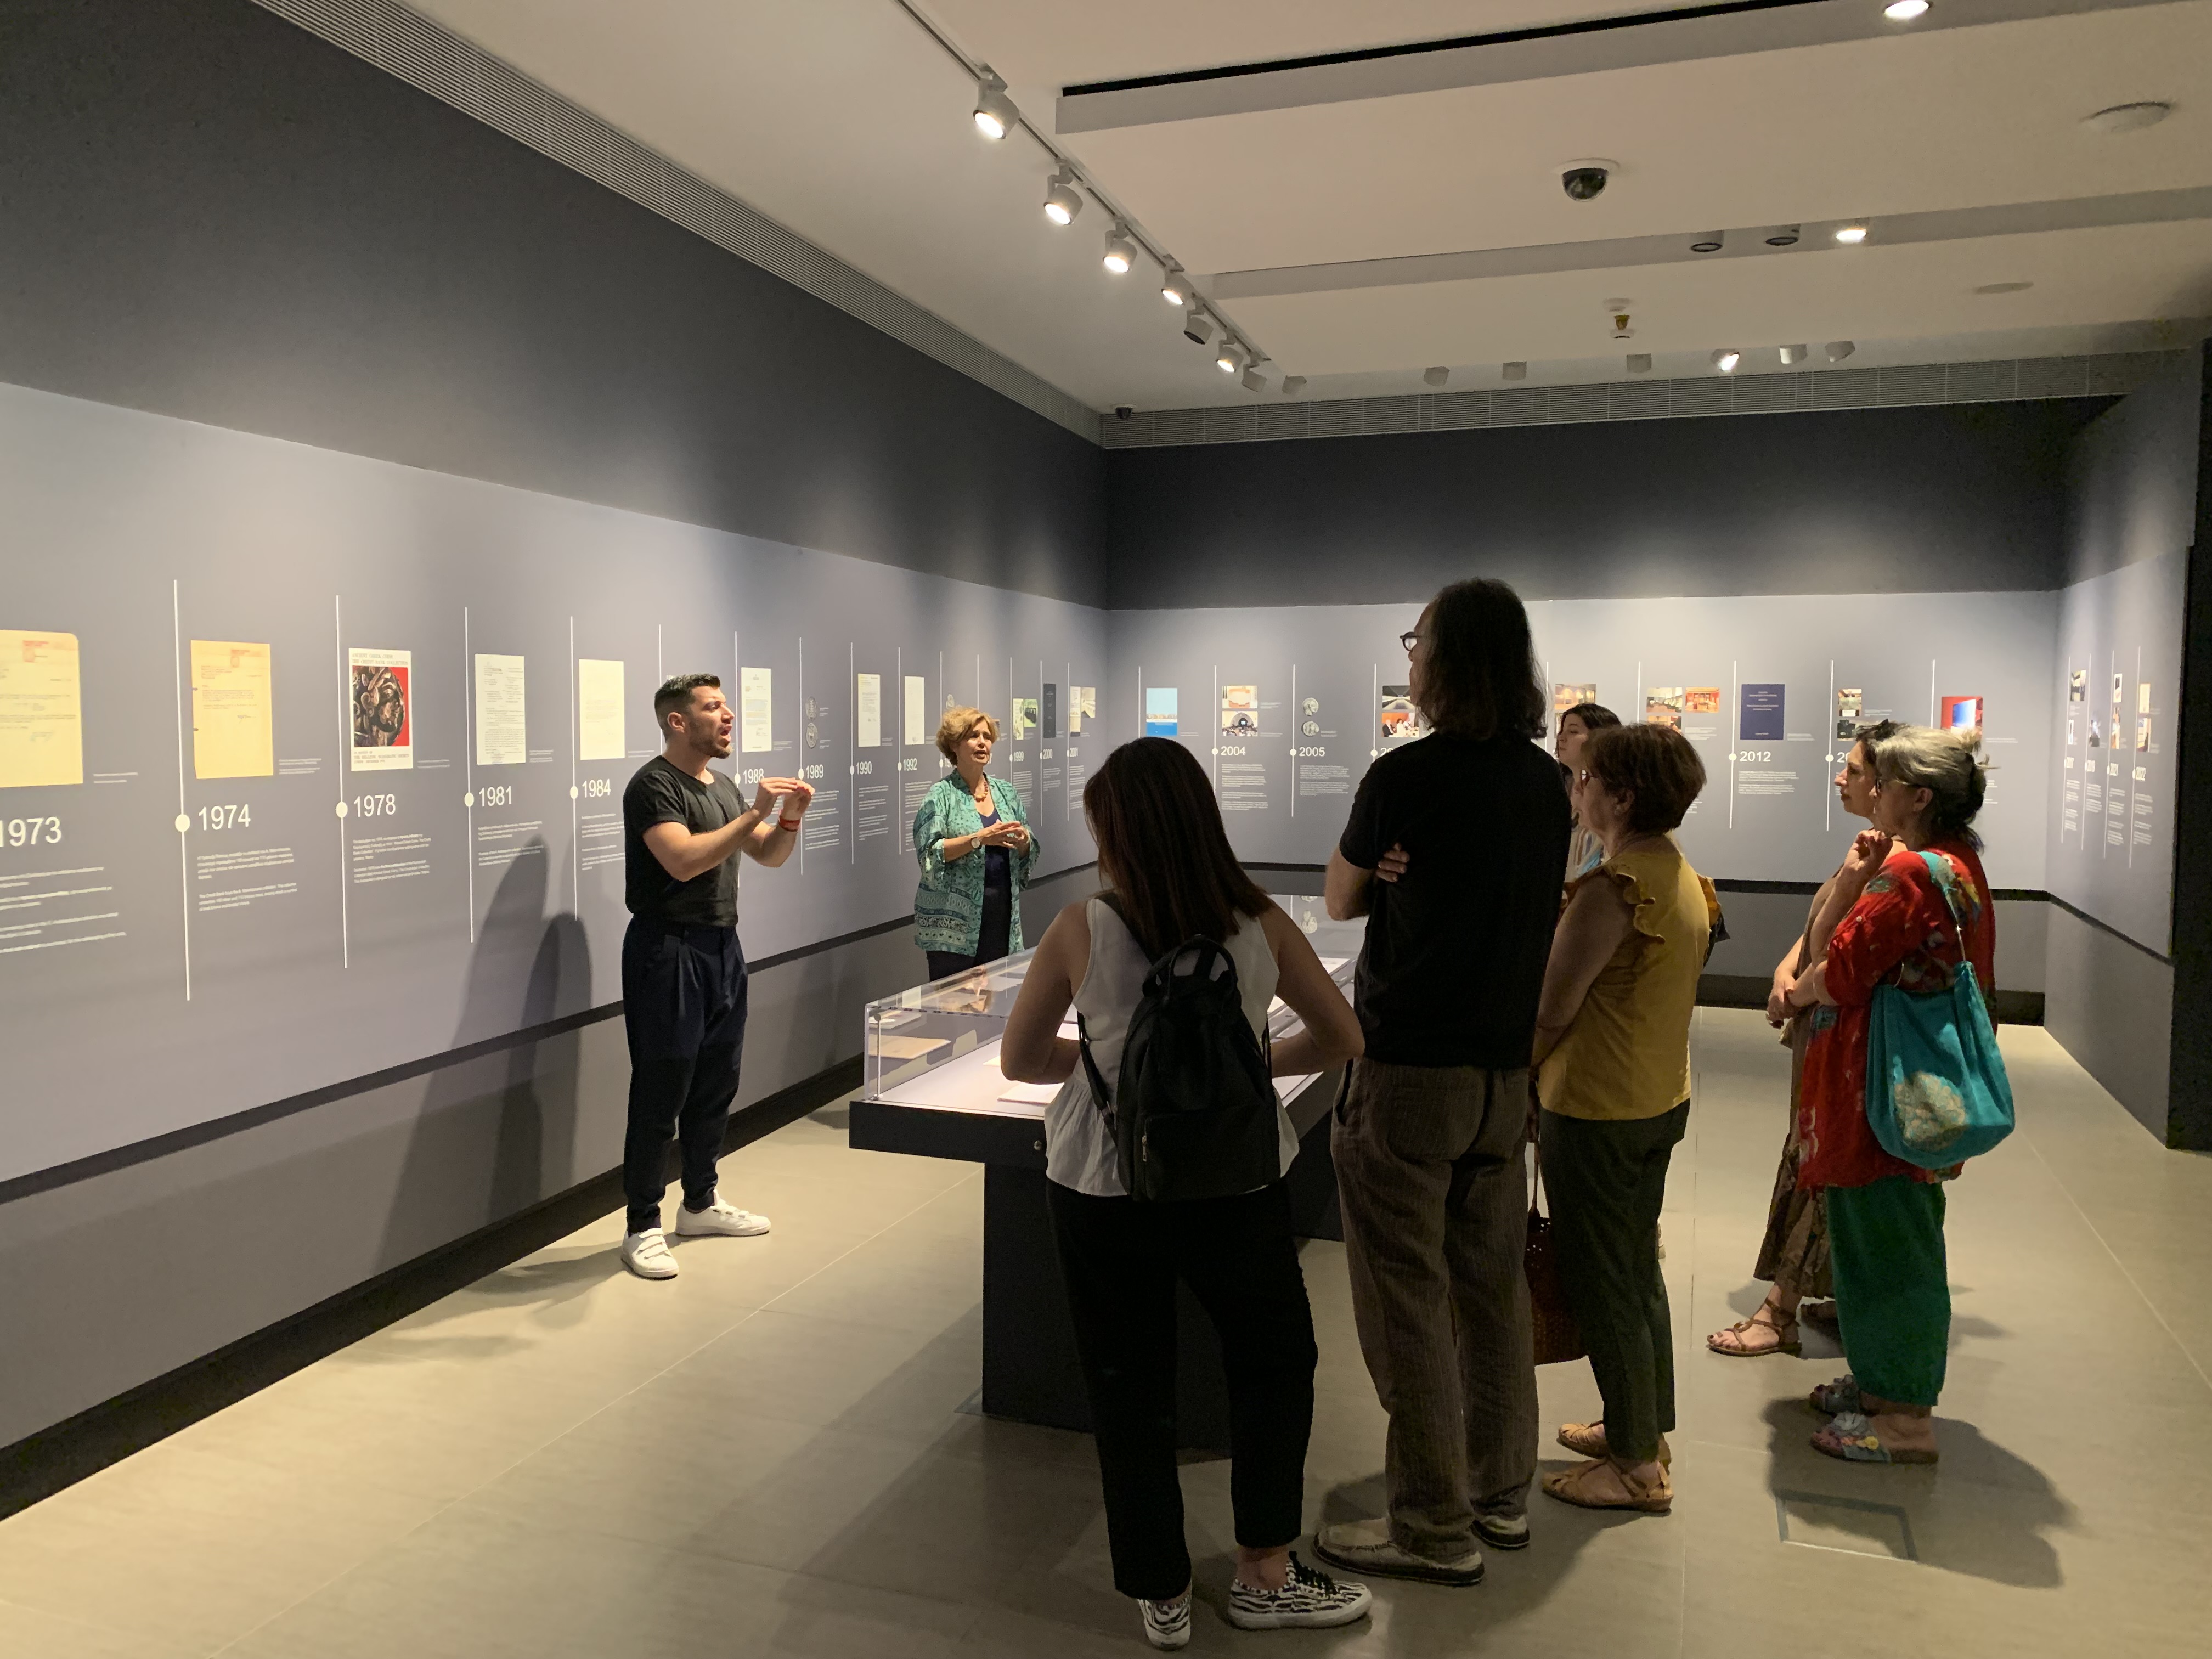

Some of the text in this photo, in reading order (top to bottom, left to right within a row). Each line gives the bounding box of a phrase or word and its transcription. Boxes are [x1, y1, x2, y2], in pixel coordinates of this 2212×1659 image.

[1043, 749, 1053, 759] 2000
[1070, 747, 1079, 758] 2001
[1221, 746, 1246, 756] 2004
[1299, 747, 1325, 757] 2005
[1740, 751, 1771, 762] 2012
[805, 764, 824, 779] 1989
[856, 761, 872, 775] 1990
[903, 758, 917, 771] 1992
[743, 769, 764, 785] 1988
[582, 778, 611, 798] 1984
[479, 785, 512, 807] 1981
[354, 794, 396, 817] 1978
[198, 804, 251, 831] 1974
